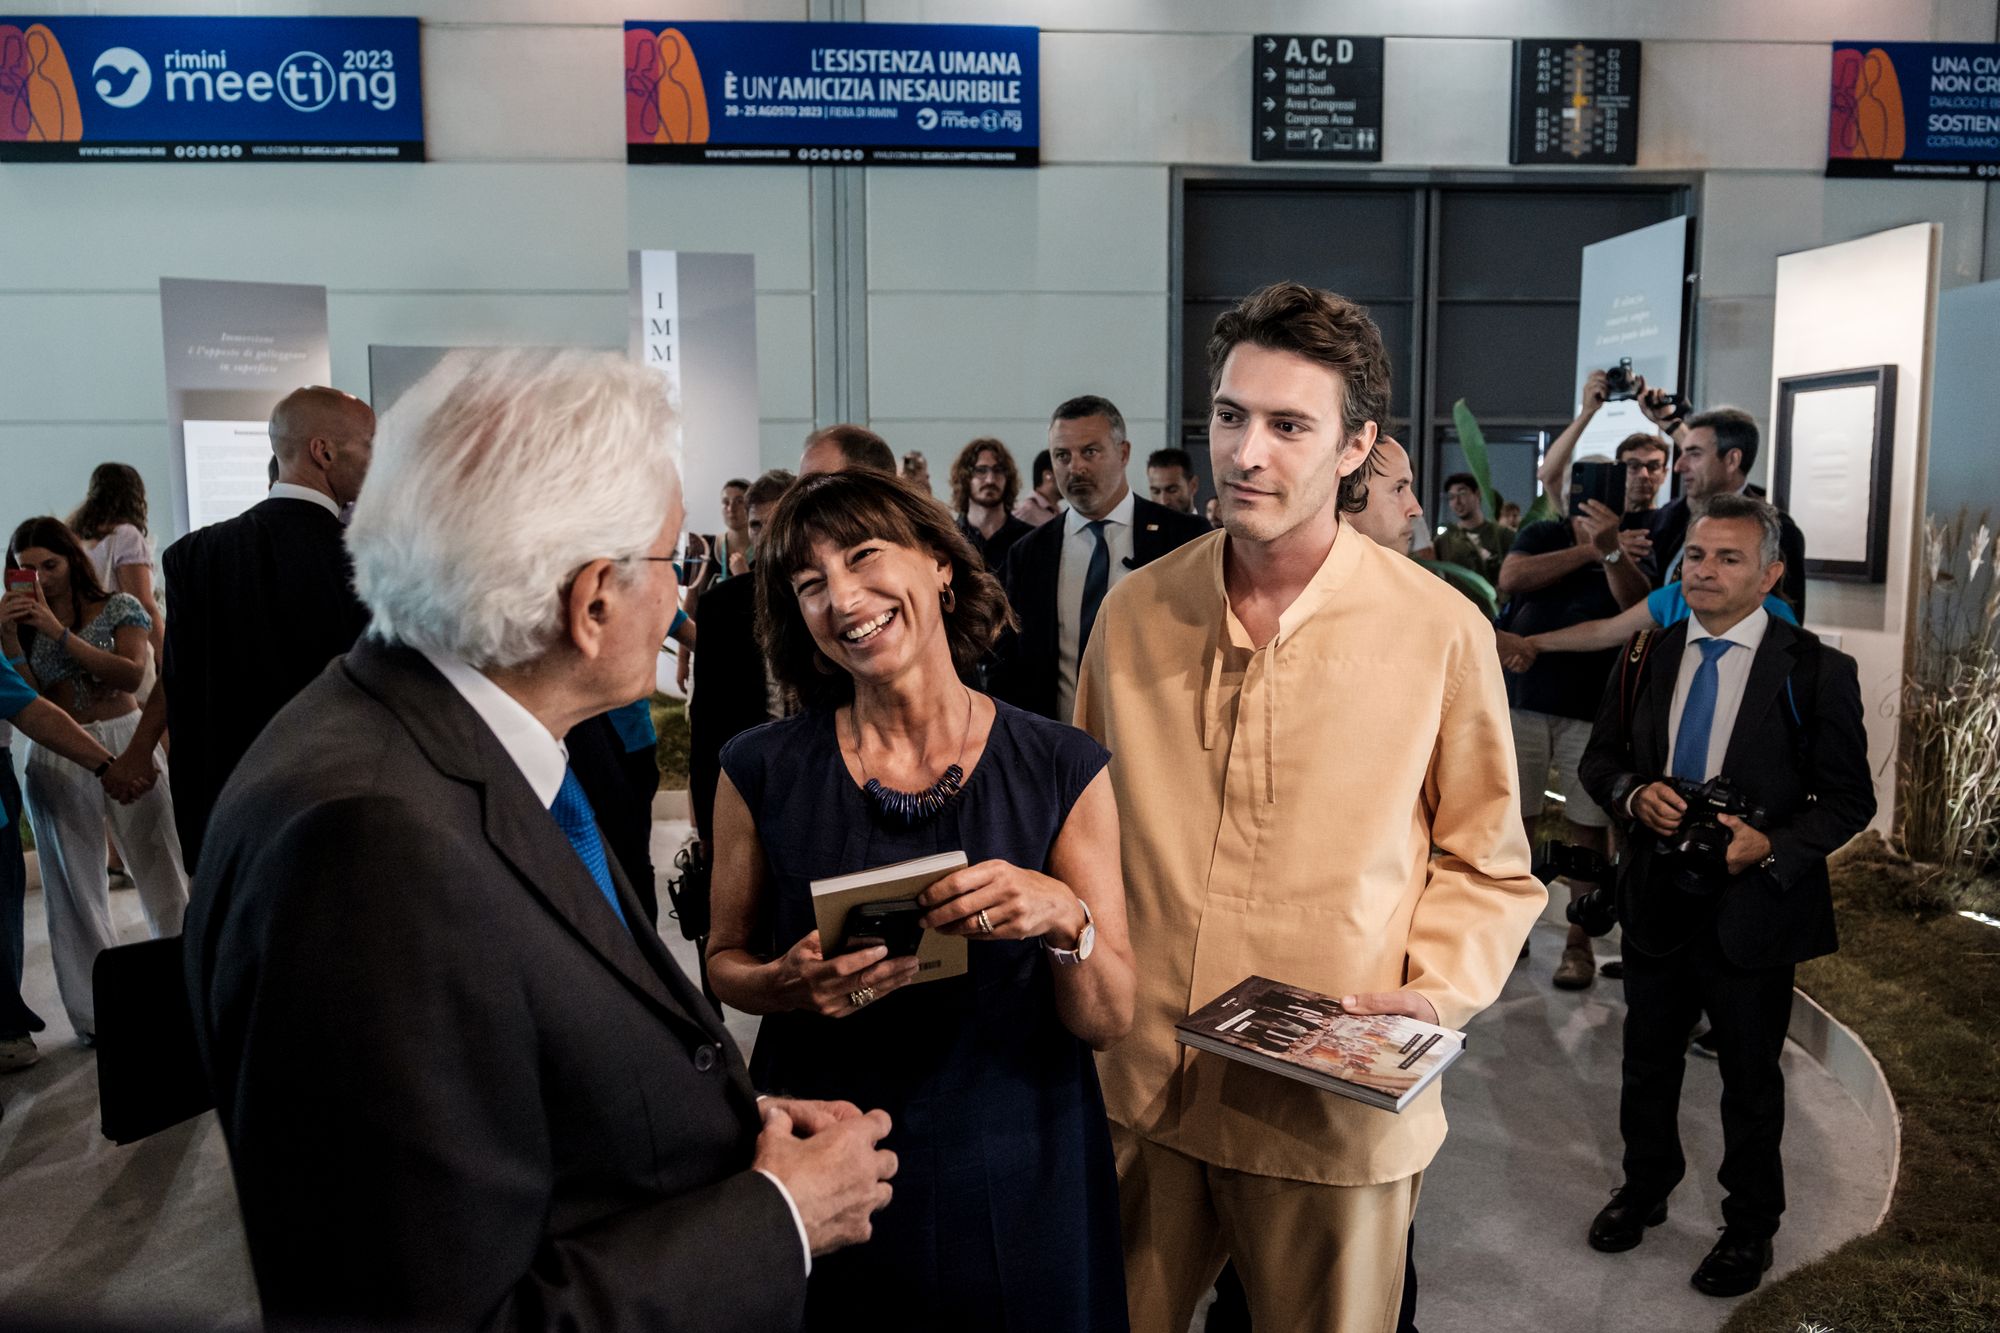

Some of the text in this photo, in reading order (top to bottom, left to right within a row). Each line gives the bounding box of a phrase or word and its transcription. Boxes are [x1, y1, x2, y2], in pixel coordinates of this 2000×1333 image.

[164, 49, 227, 69] rimini
[343, 49, 394, 69] 2023
[811, 48, 1021, 75] L'ESISTENZA UMANA
[1284, 38, 1354, 66] A, C, D
[1285, 67, 1327, 81] Hall Sud
[1932, 56, 1970, 74] UNA
[165, 60, 397, 111] meeting
[724, 70, 738, 99] È
[879, 79, 1021, 104] INESAURIBILE
[1285, 82, 1335, 96] Hall South
[1931, 74, 1971, 93] NON
[758, 105, 797, 117] AGOSTO
[798, 105, 823, 118] 2023
[1284, 97, 1308, 110] Area
[941, 112, 1022, 132] meeting
[1285, 111, 1354, 127] Congress Area
[1286, 130, 1306, 140] EXIT
[1630, 629, 1650, 662] Canon
